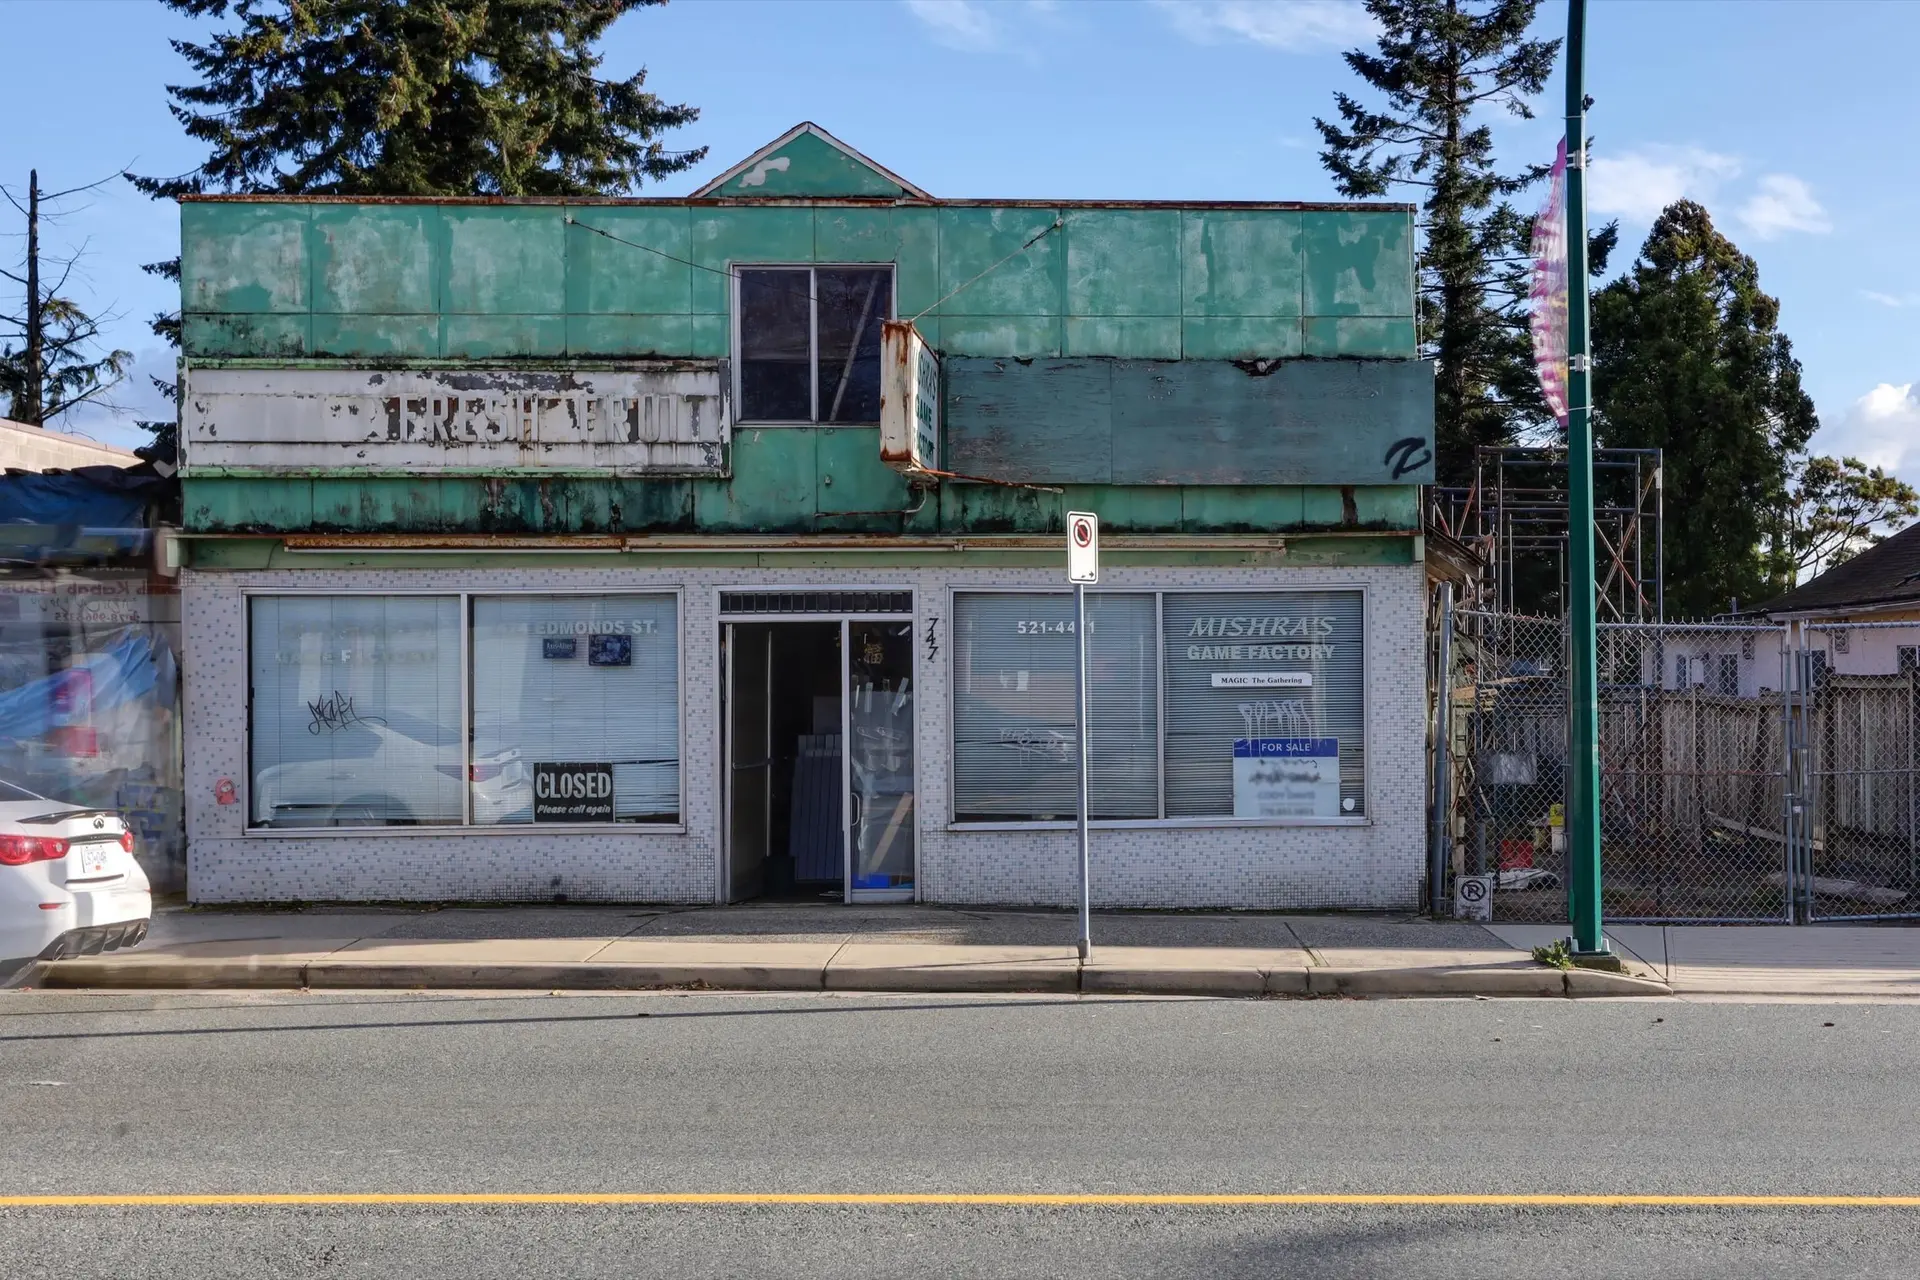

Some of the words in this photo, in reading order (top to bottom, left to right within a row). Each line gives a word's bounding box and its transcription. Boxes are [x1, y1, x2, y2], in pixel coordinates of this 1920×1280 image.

[399, 393, 540, 442] FRESH
[579, 394, 721, 443] FRUIT
[915, 393, 932, 431] GAME
[535, 619, 625, 634] EDMONDS
[632, 618, 658, 634] ST.
[1018, 620, 1095, 634] 521-441
[1188, 616, 1337, 637] MISHRA'S
[926, 617, 939, 660] 747
[1187, 645, 1242, 660] GAME
[1249, 644, 1336, 660] FACTORY
[1267, 677, 1303, 685] Gathering
[1261, 743, 1283, 752] FOR
[1286, 743, 1310, 752] SALE
[536, 772, 612, 799] CLOSED
[537, 804, 567, 814] Please
[568, 804, 585, 814] call
[586, 804, 611, 816] again
